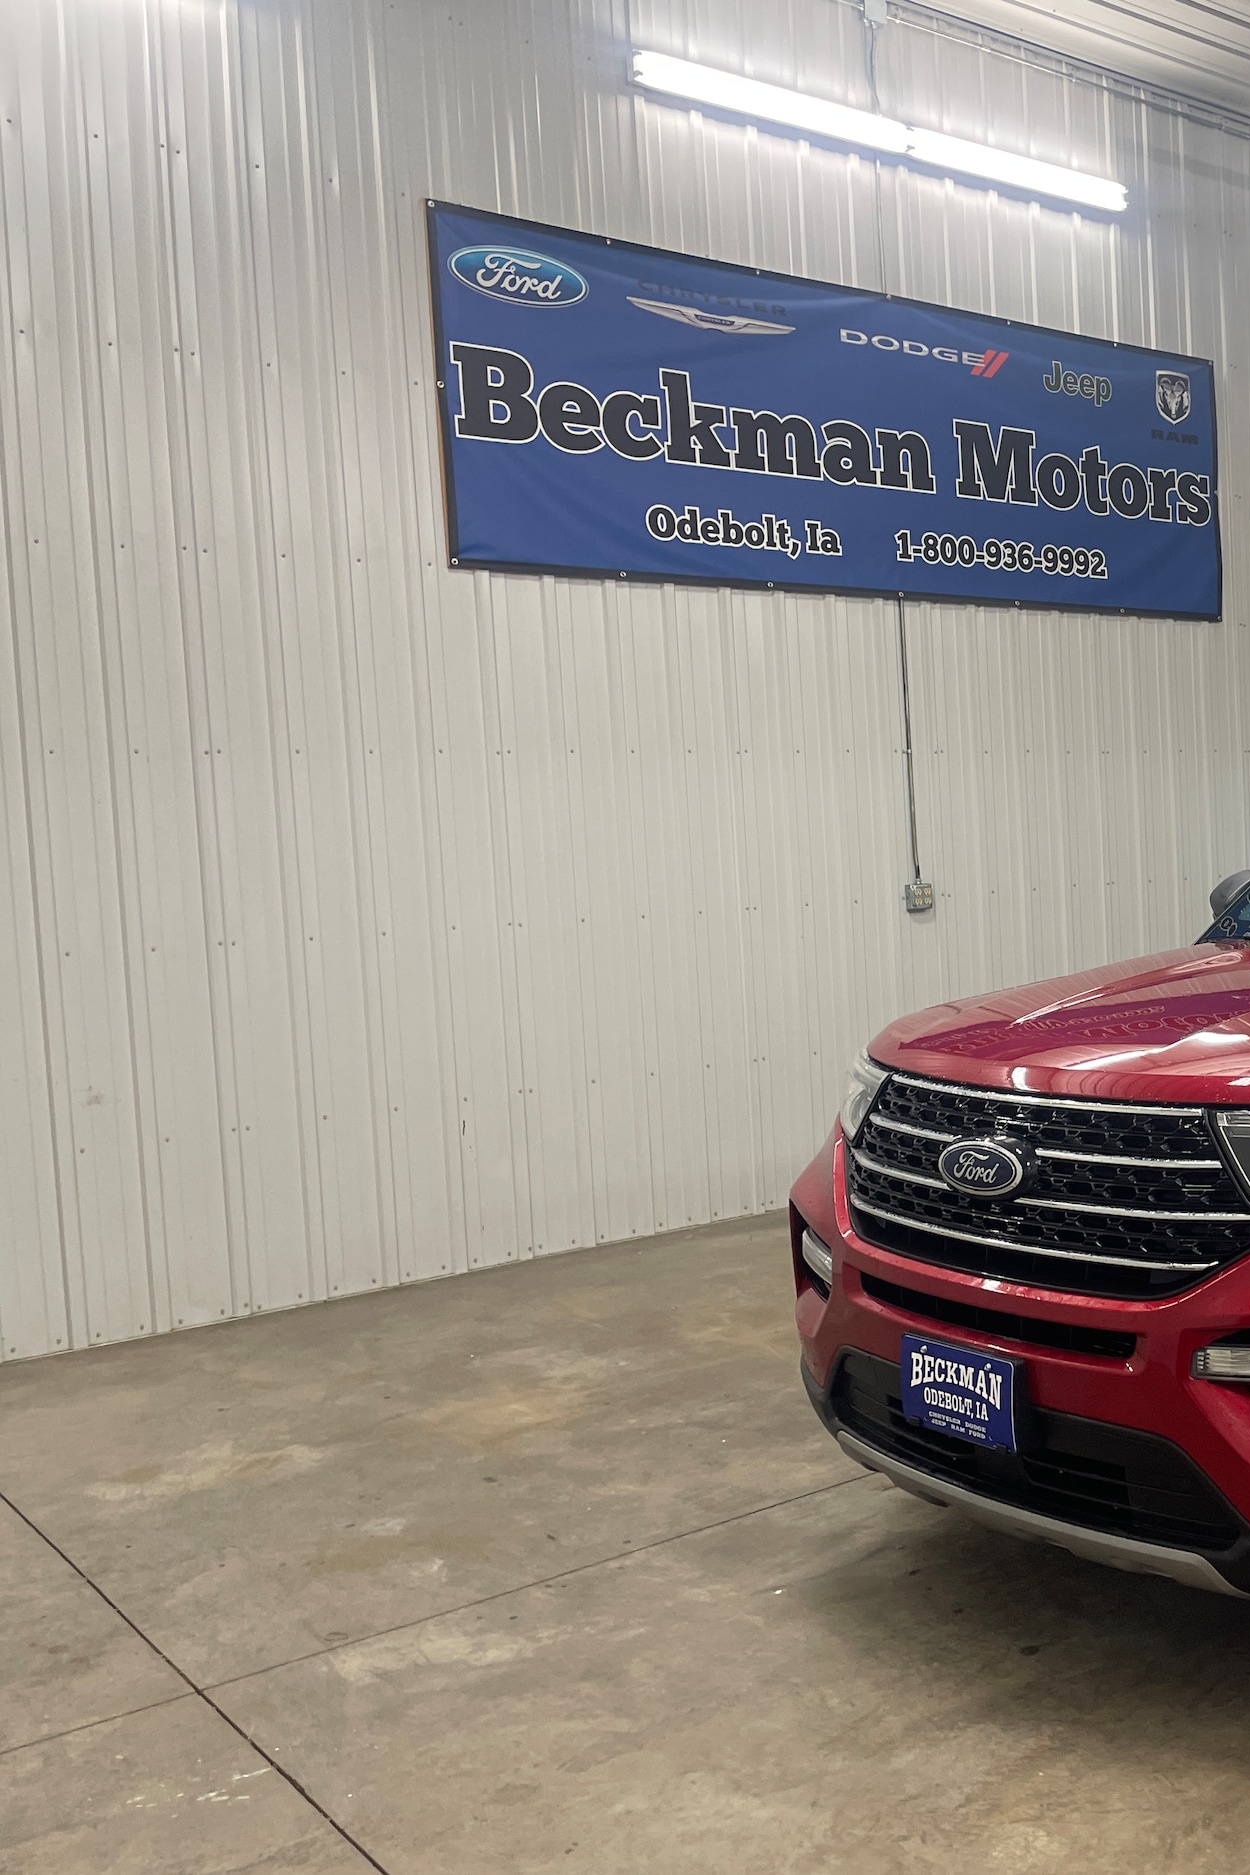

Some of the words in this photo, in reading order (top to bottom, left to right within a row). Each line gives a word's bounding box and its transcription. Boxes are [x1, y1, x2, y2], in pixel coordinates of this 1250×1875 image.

[475, 251, 564, 301] Ford
[638, 279, 786, 317] CHRYSLER
[839, 328, 986, 367] DODGE
[1043, 361, 1112, 407] Jeep
[449, 341, 937, 495] Beckman
[953, 419, 1212, 527] Motors
[1151, 429, 1199, 446] RAM
[645, 504, 801, 560] Odebolt,
[804, 521, 843, 557] Ia
[895, 530, 1108, 580] 1-800-936-9992
[953, 1150, 1000, 1184] Ford
[910, 1351, 1003, 1411] BECKMAN
[923, 1386, 974, 1419] ODEBOLT,
[975, 1401, 989, 1421] IA
[951, 1424, 965, 1433] RAM
[968, 1430, 985, 1439] FORD
[965, 1421, 986, 1433] DODGE
